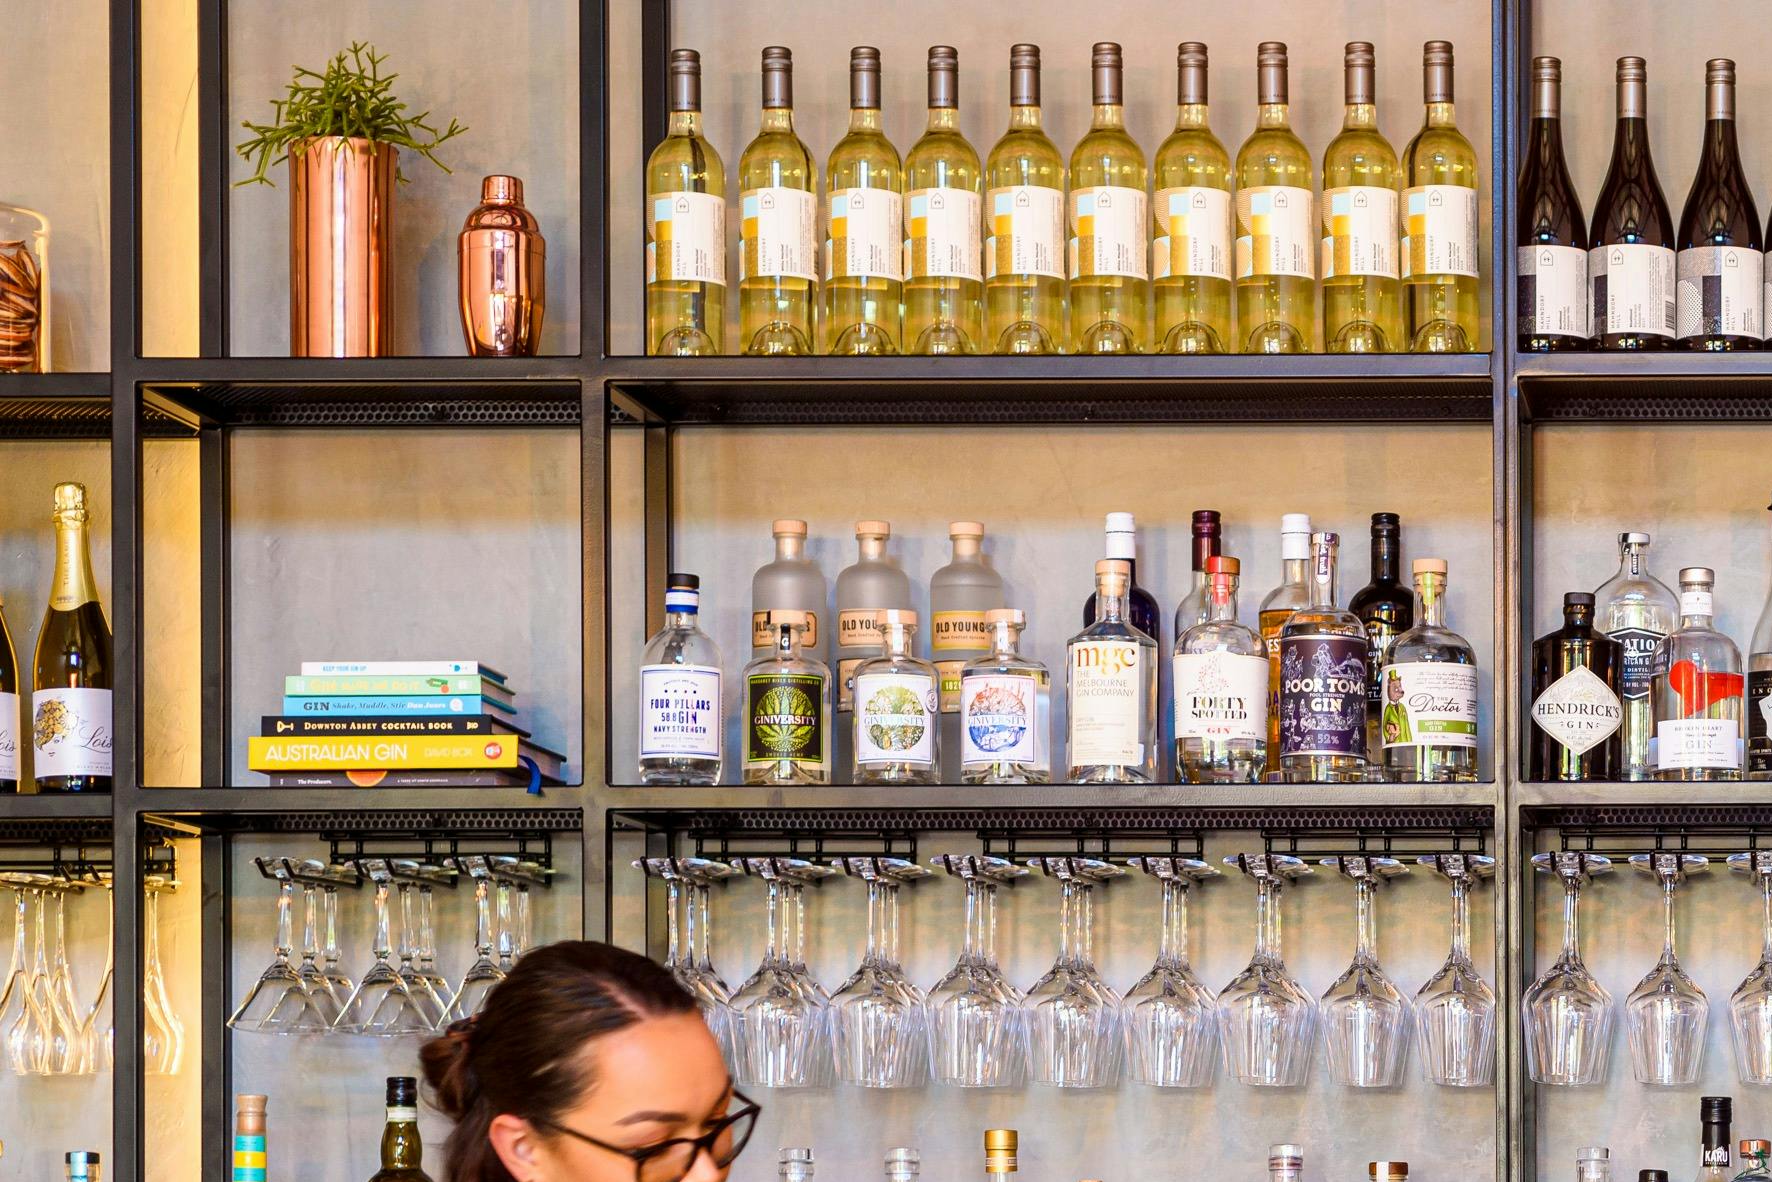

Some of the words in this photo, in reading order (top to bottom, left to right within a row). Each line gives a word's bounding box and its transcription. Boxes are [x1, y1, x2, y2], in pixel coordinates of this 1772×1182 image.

[842, 620, 857, 631] OLD
[936, 622, 950, 632] OLD
[952, 621, 985, 632] YOUNG
[1077, 647, 1135, 675] mgc
[1076, 679, 1127, 687] MELBOURNE
[1285, 679, 1324, 694] POOR
[1327, 679, 1365, 695] TOMS
[1091, 689, 1134, 697] COMPANY
[304, 702, 330, 711] GIN
[651, 699, 670, 710] FOUR
[674, 700, 711, 710] PILLARS
[1192, 697, 1246, 709] FORTY
[1311, 699, 1343, 712] GIN
[1409, 693, 1461, 712] Doctor
[1191, 710, 1247, 719] SPOTTED
[1538, 703, 1620, 719] HENDRICK'S
[679, 711, 697, 724] GIN
[754, 715, 816, 726] GINIVERSITY
[381, 722, 425, 730] COCKTAIL
[428, 722, 453, 730] BOOK
[1567, 721, 1594, 729] GIN
[1318, 733, 1340, 744] 52%
[1686, 740, 1712, 748] GIN
[266, 744, 370, 761] AUSTRALIAN
[375, 744, 407, 761] GIN
[1705, 1150, 1728, 1163] KARU
